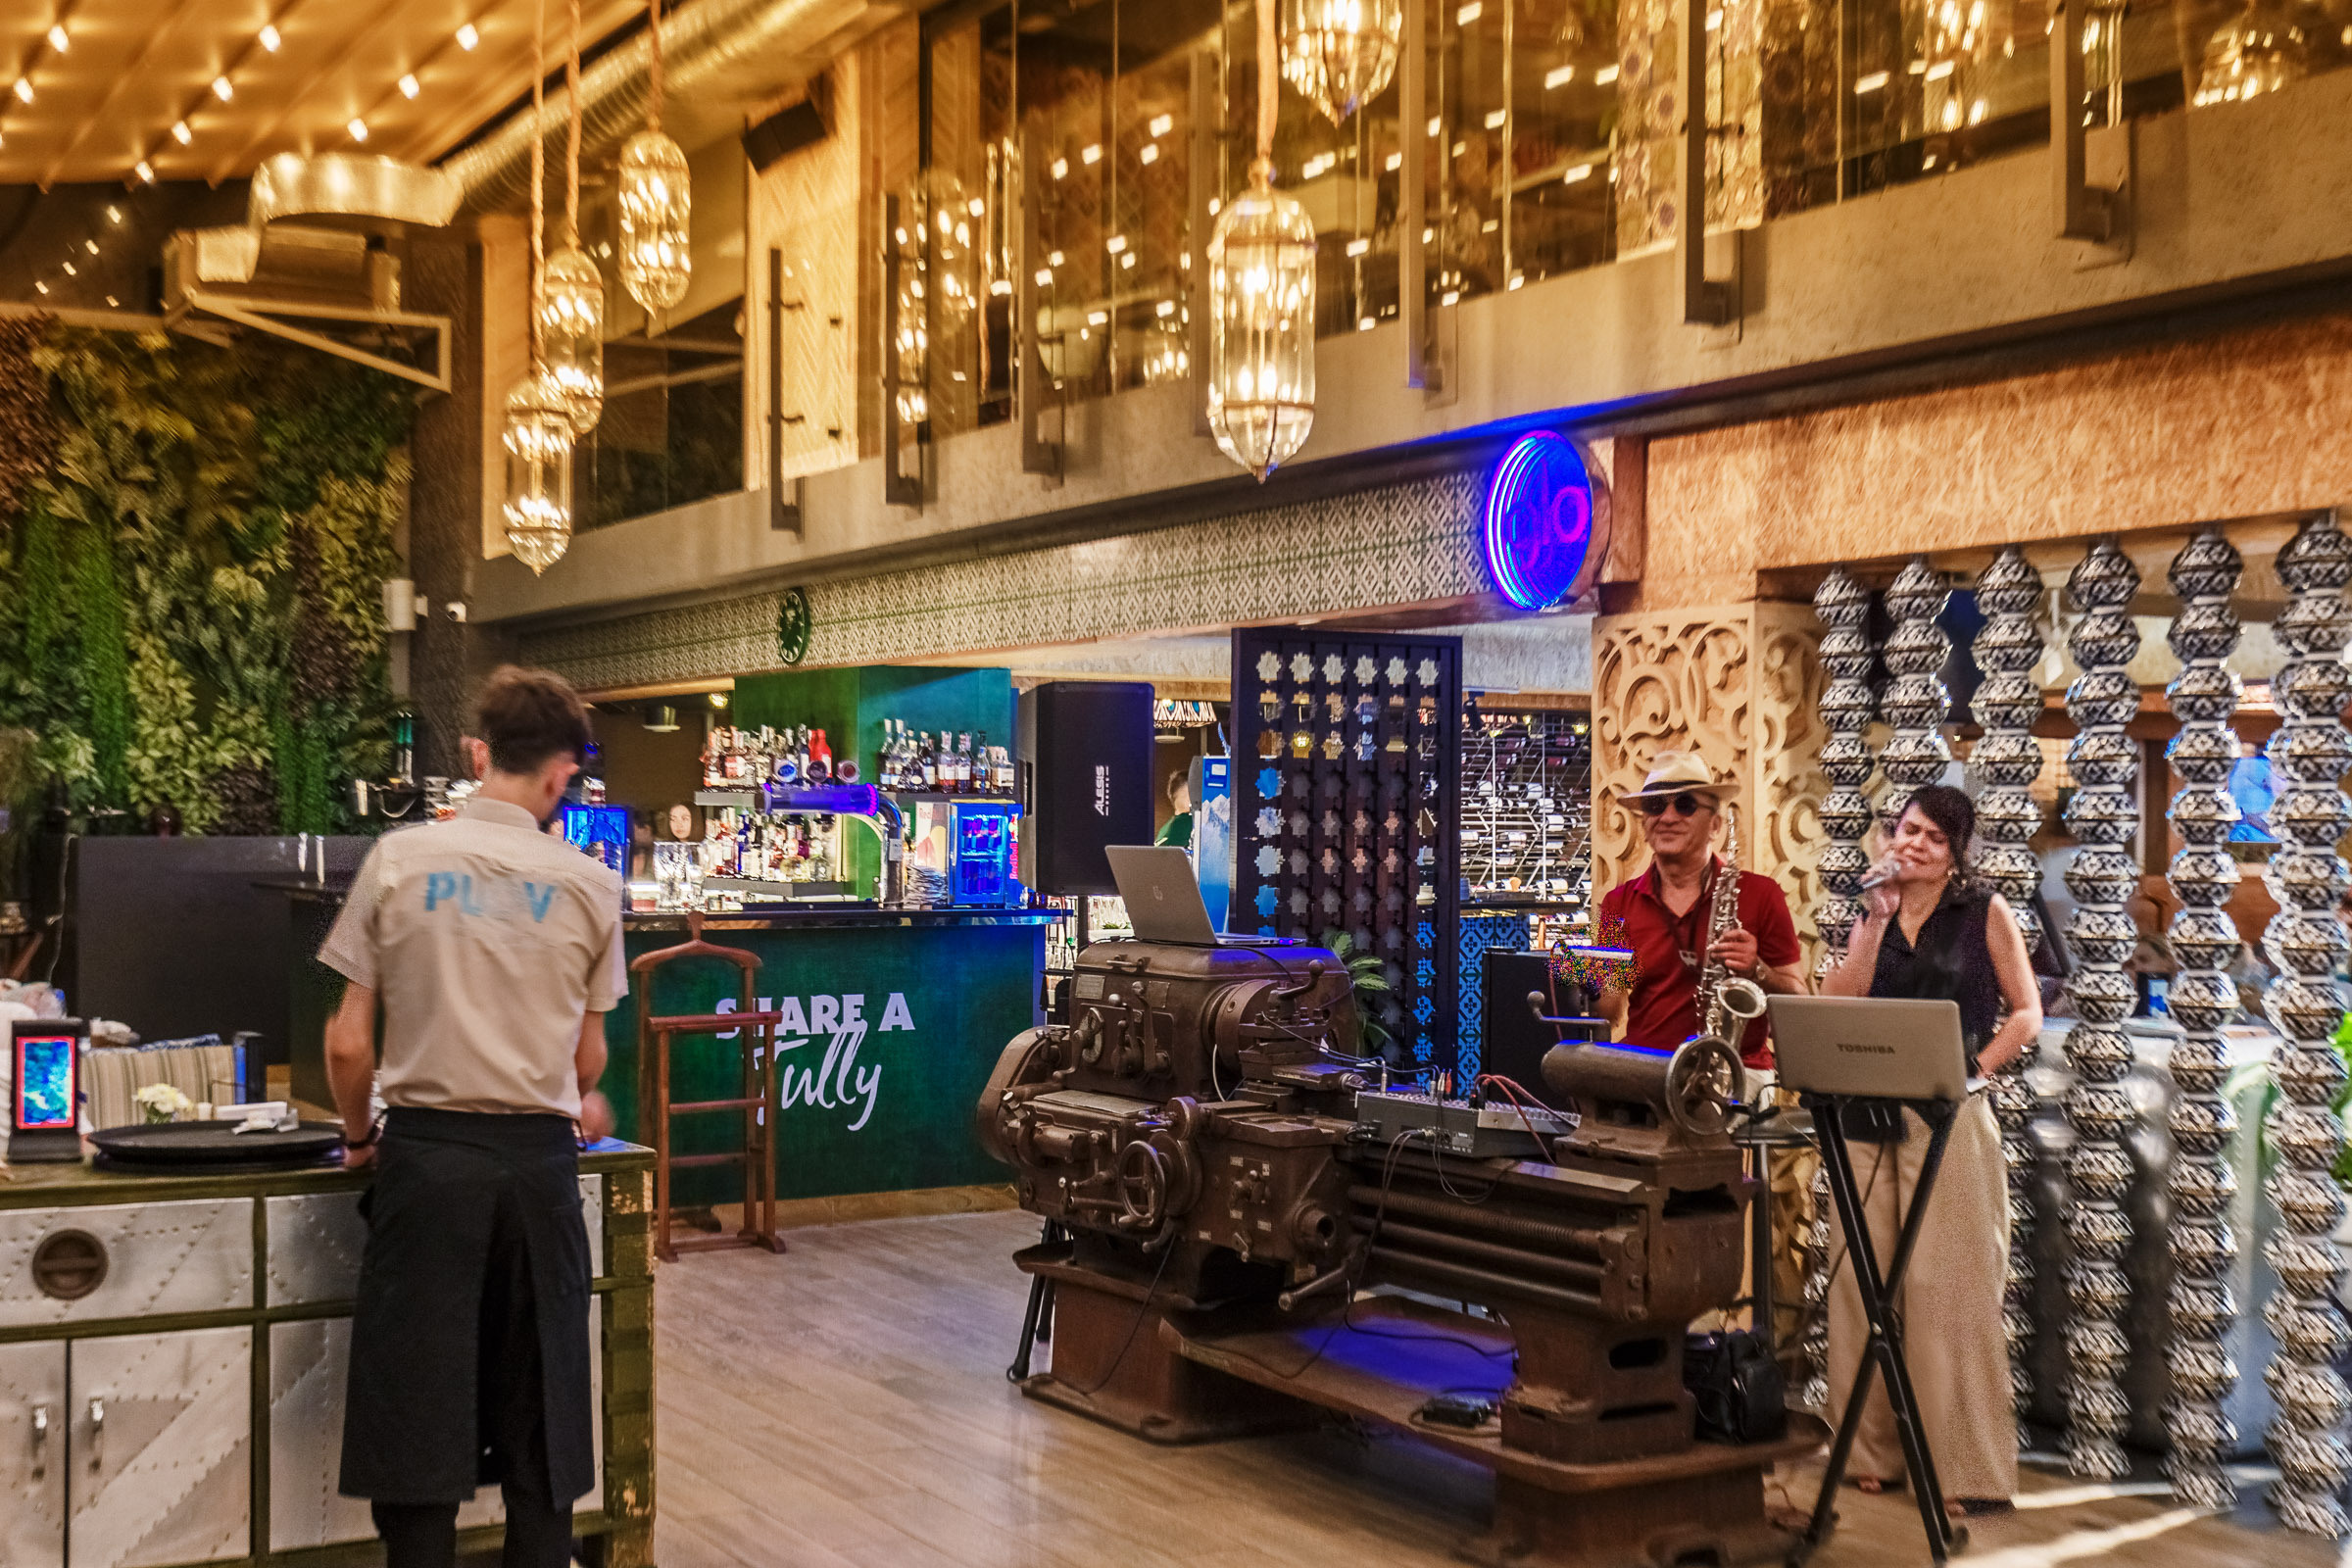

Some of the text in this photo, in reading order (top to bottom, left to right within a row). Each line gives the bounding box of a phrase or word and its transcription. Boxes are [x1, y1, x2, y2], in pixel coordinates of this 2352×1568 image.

[1095, 764, 1105, 816] ALESIS
[424, 871, 557, 924] PLV
[878, 992, 915, 1031] A
[1836, 1043, 1895, 1054] TOSHIBA
